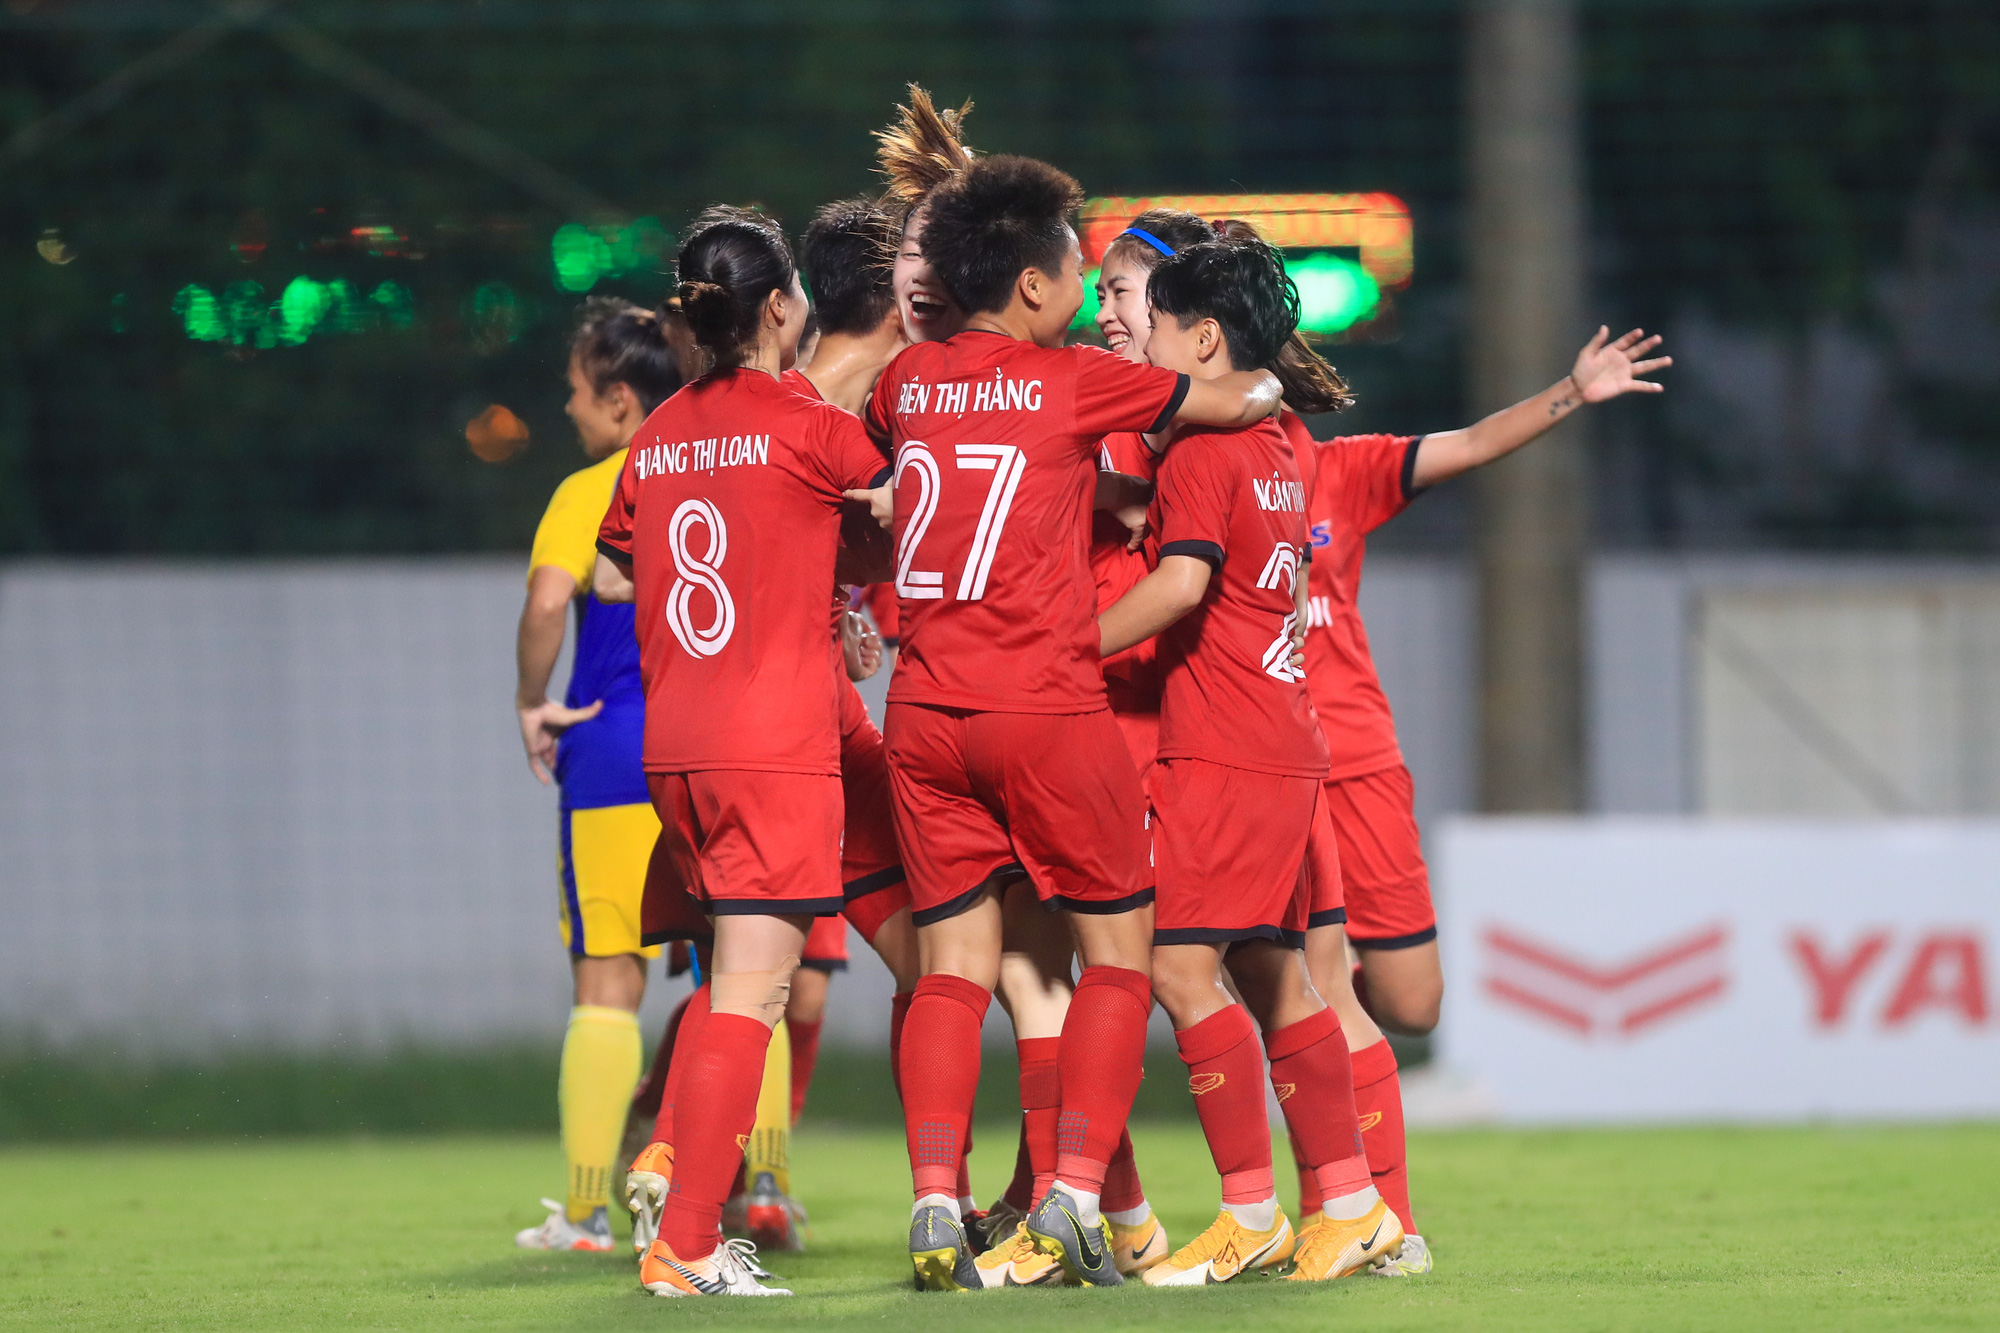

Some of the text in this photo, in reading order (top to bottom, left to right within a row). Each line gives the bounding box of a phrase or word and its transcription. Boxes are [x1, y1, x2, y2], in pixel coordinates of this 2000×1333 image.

[934, 382, 969, 419] THỊ
[972, 366, 1042, 411] HẰNG
[634, 434, 770, 479] HOÀNG THỊ LOAN
[1252, 470, 1292, 512] NGÂN
[893, 440, 1027, 601] 27
[665, 497, 736, 660] 8
[1787, 926, 1991, 1029] YA
